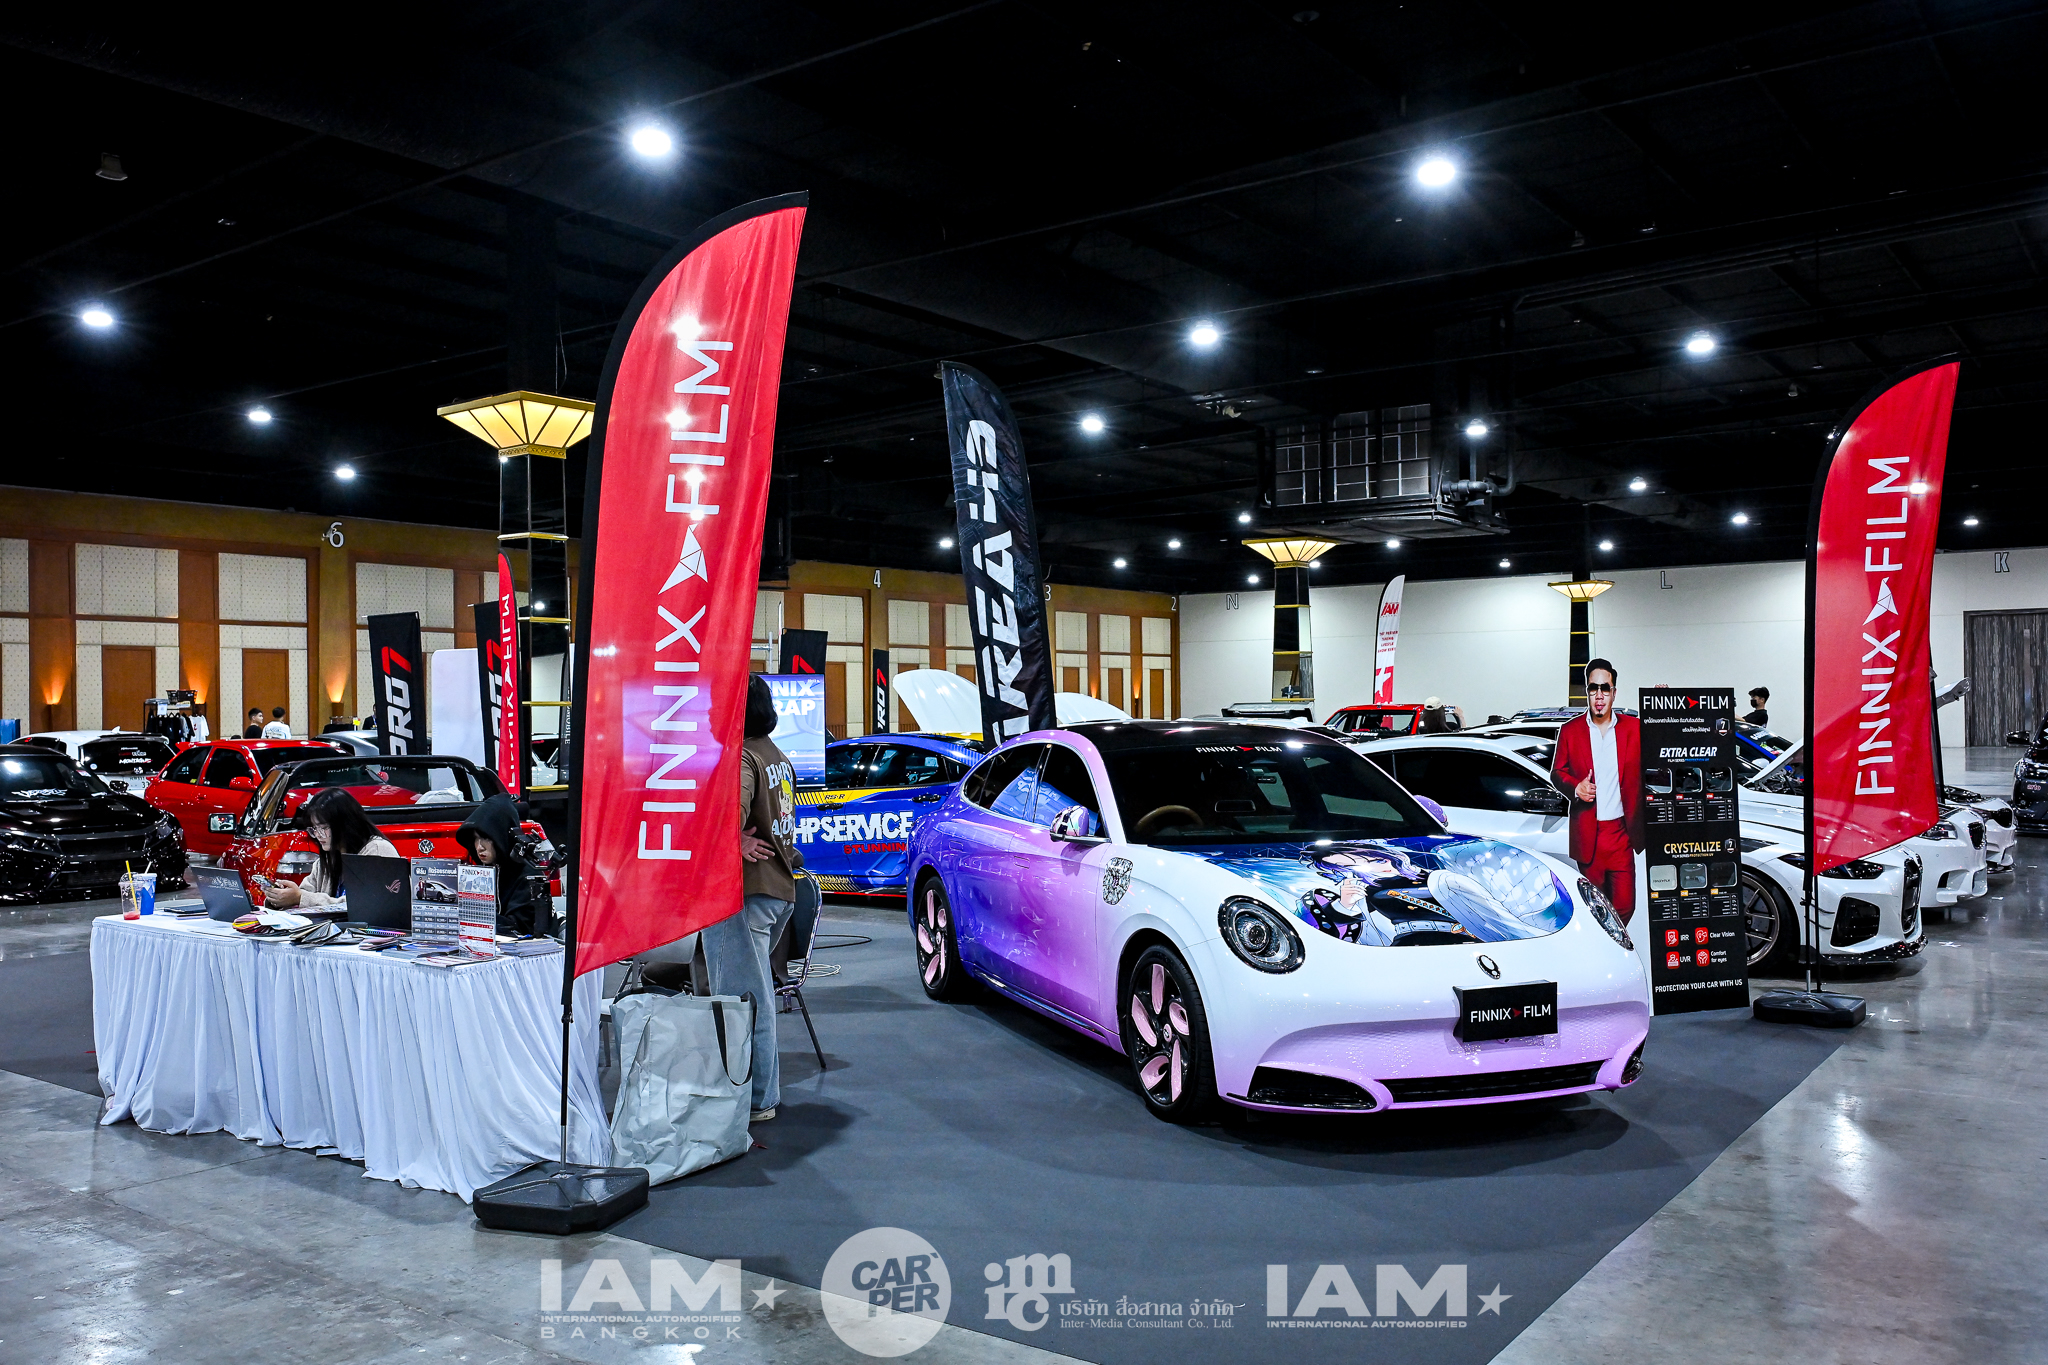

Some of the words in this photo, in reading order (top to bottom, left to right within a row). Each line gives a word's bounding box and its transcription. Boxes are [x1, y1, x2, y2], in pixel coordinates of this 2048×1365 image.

[665, 340, 734, 515] FILM
[1865, 456, 1910, 572] FILM
[329, 521, 345, 548] 6
[1994, 552, 2010, 573] K
[873, 569, 881, 588] 4
[1660, 570, 1673, 589] L
[1044, 584, 1052, 601] 3
[1225, 593, 1239, 610] N
[1171, 596, 1177, 611] 2
[1643, 695, 1686, 710] FINNIX
[1699, 695, 1729, 709] FILM
[1854, 629, 1900, 795] FINNIX
[637, 605, 706, 860] FINNIX
[1659, 747, 1688, 758] EXTRA
[1689, 746, 1718, 757] CLEAR
[1664, 841, 1721, 855] CRYSTALIZE
[1655, 983, 1690, 993] PROTECTION
[1690, 981, 1706, 990] YOUR
[1706, 980, 1719, 988] CAR
[1719, 979, 1734, 988] WITH
[1734, 978, 1743, 986] US
[1470, 1007, 1512, 1023] FINNIX
[1523, 1003, 1551, 1018] FILM
